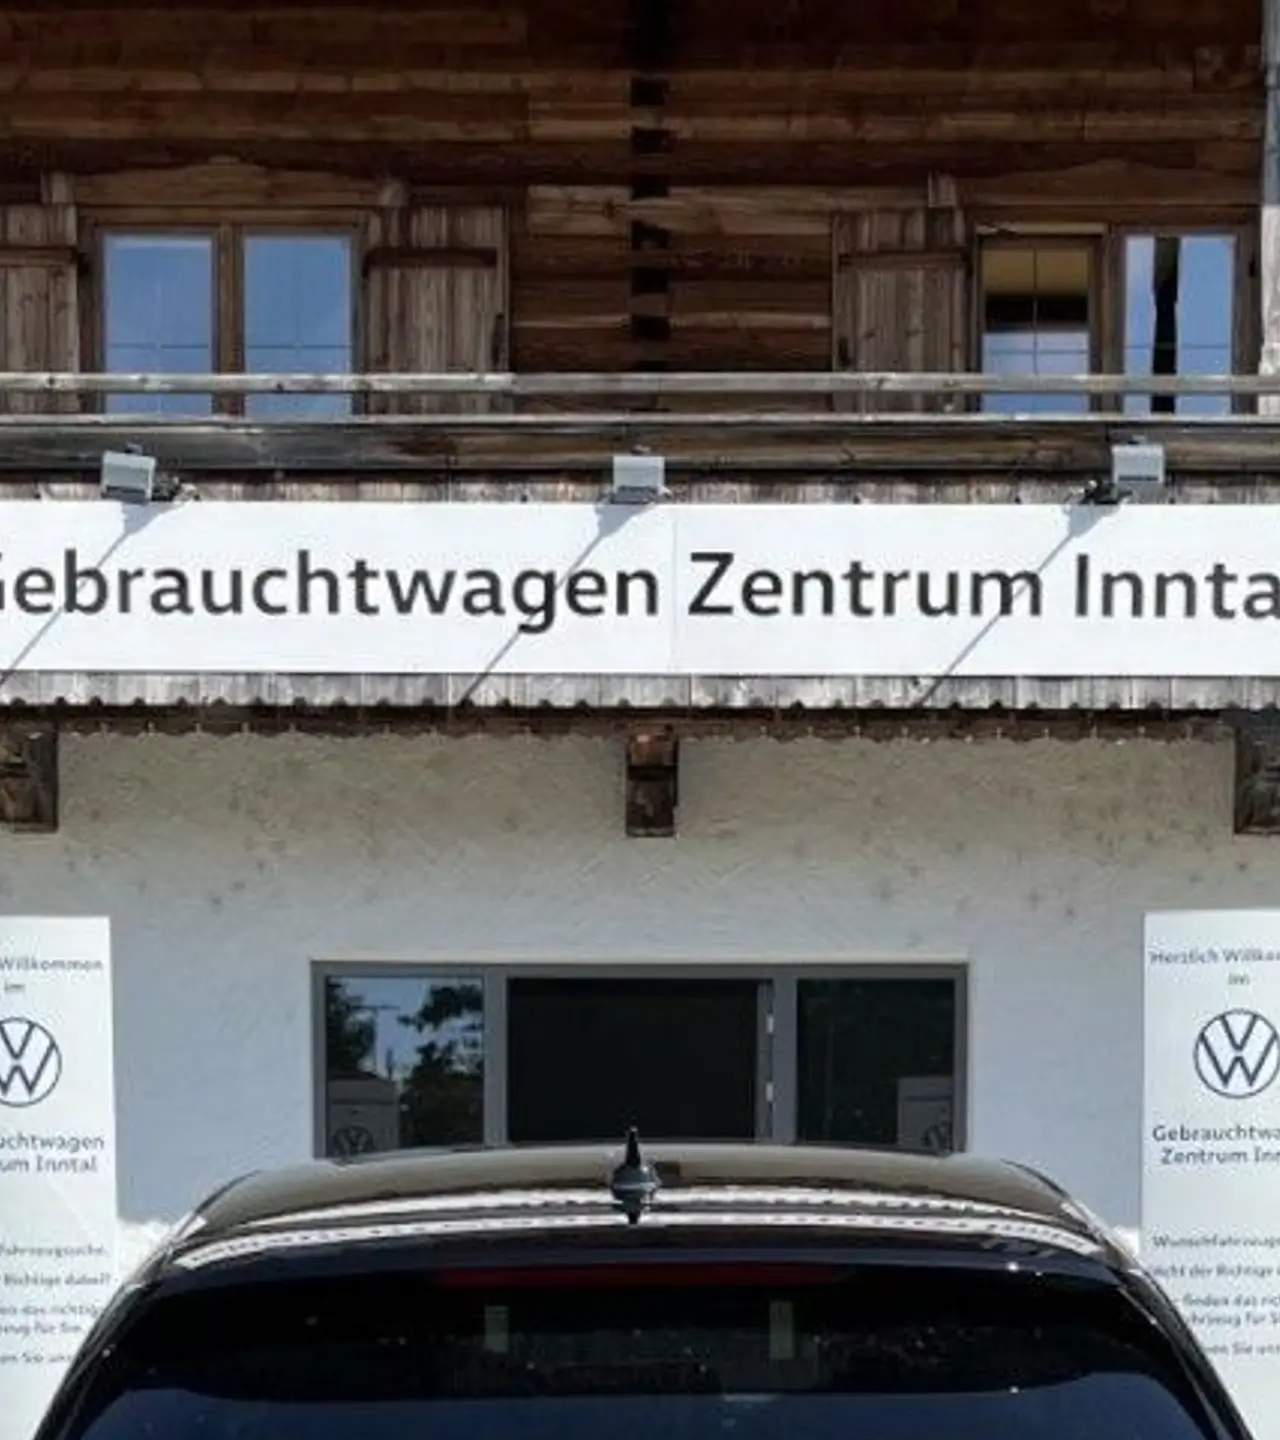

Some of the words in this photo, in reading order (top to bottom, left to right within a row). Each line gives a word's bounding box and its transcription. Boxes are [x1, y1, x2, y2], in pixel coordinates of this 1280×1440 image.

[688, 550, 1043, 618] Zentrum
[1149, 949, 1219, 965] Herzlich
[3, 980, 26, 993] im
[1228, 973, 1250, 986] im
[35, 1153, 99, 1174] Inntal
[1160, 1146, 1249, 1167] Zentrum
